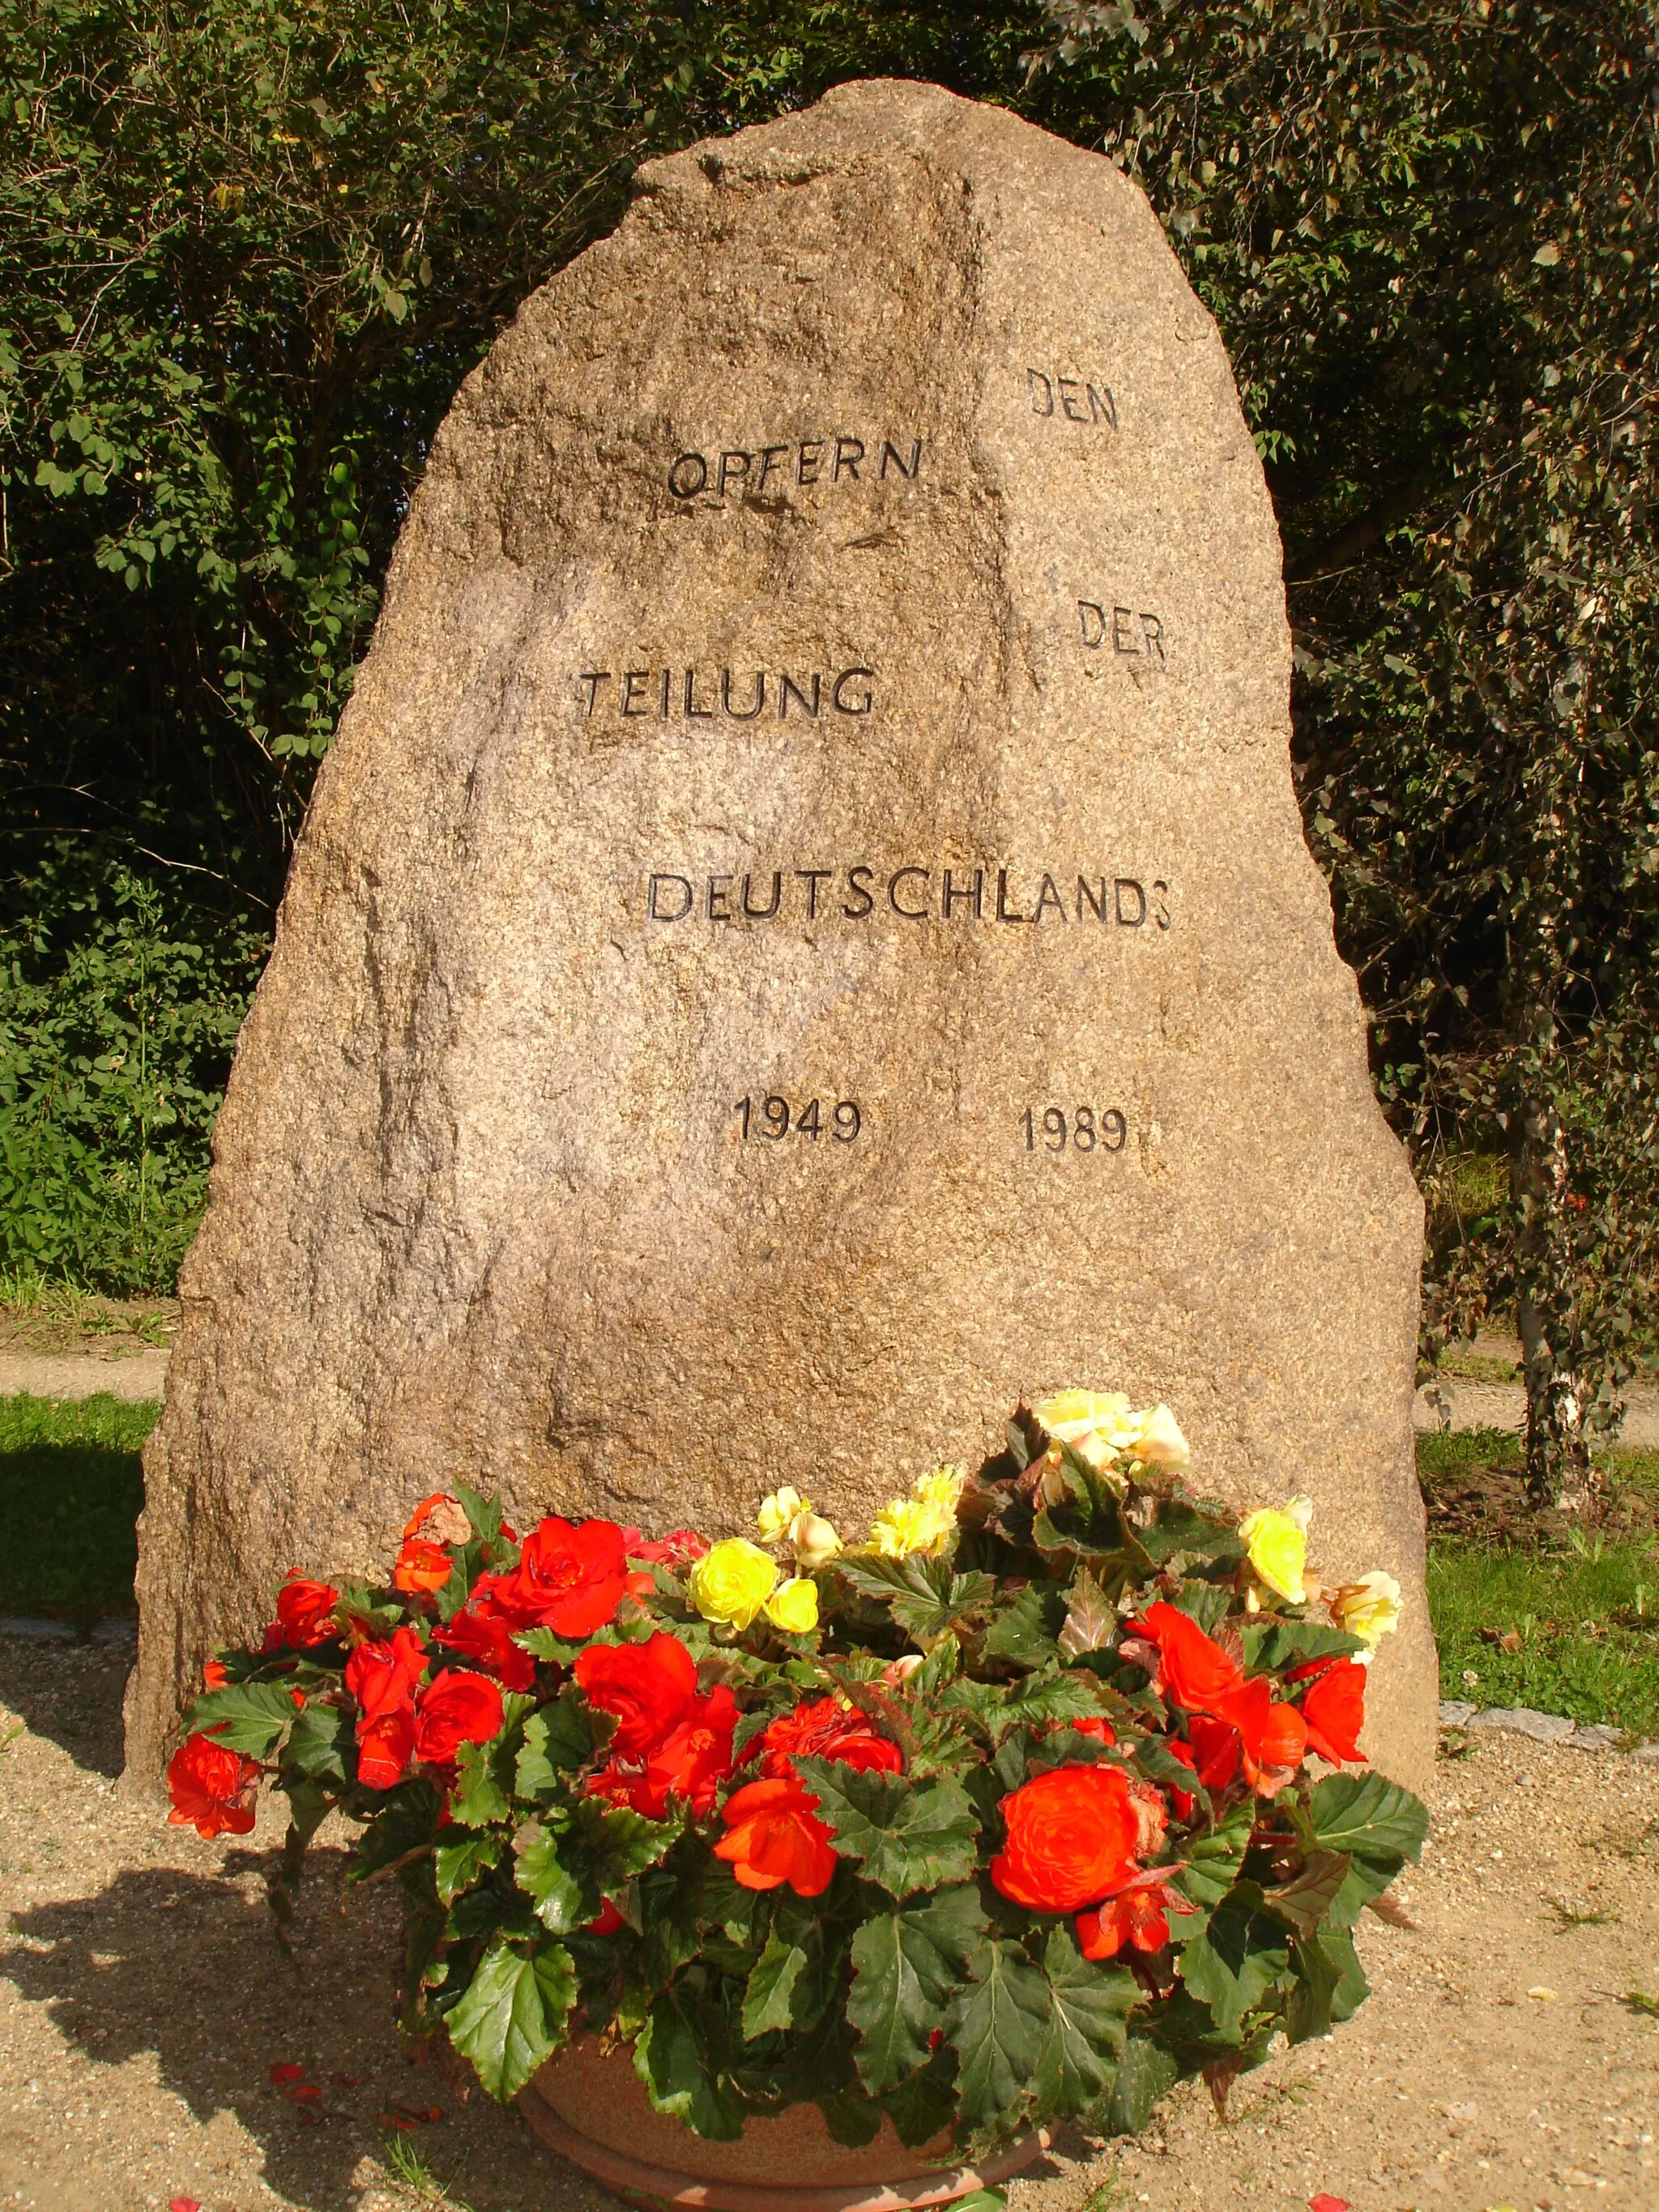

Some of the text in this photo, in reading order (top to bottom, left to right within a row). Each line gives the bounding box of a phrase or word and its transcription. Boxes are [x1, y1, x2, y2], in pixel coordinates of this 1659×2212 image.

[1026, 368, 1119, 429] DEN
[667, 438, 922, 499] OPFERN
[1077, 600, 1166, 661] DER
[579, 667, 875, 721] TEILUNG
[647, 866, 1171, 931] DEUTSCHLANDS
[733, 1096, 1127, 1153] 1949 1989
